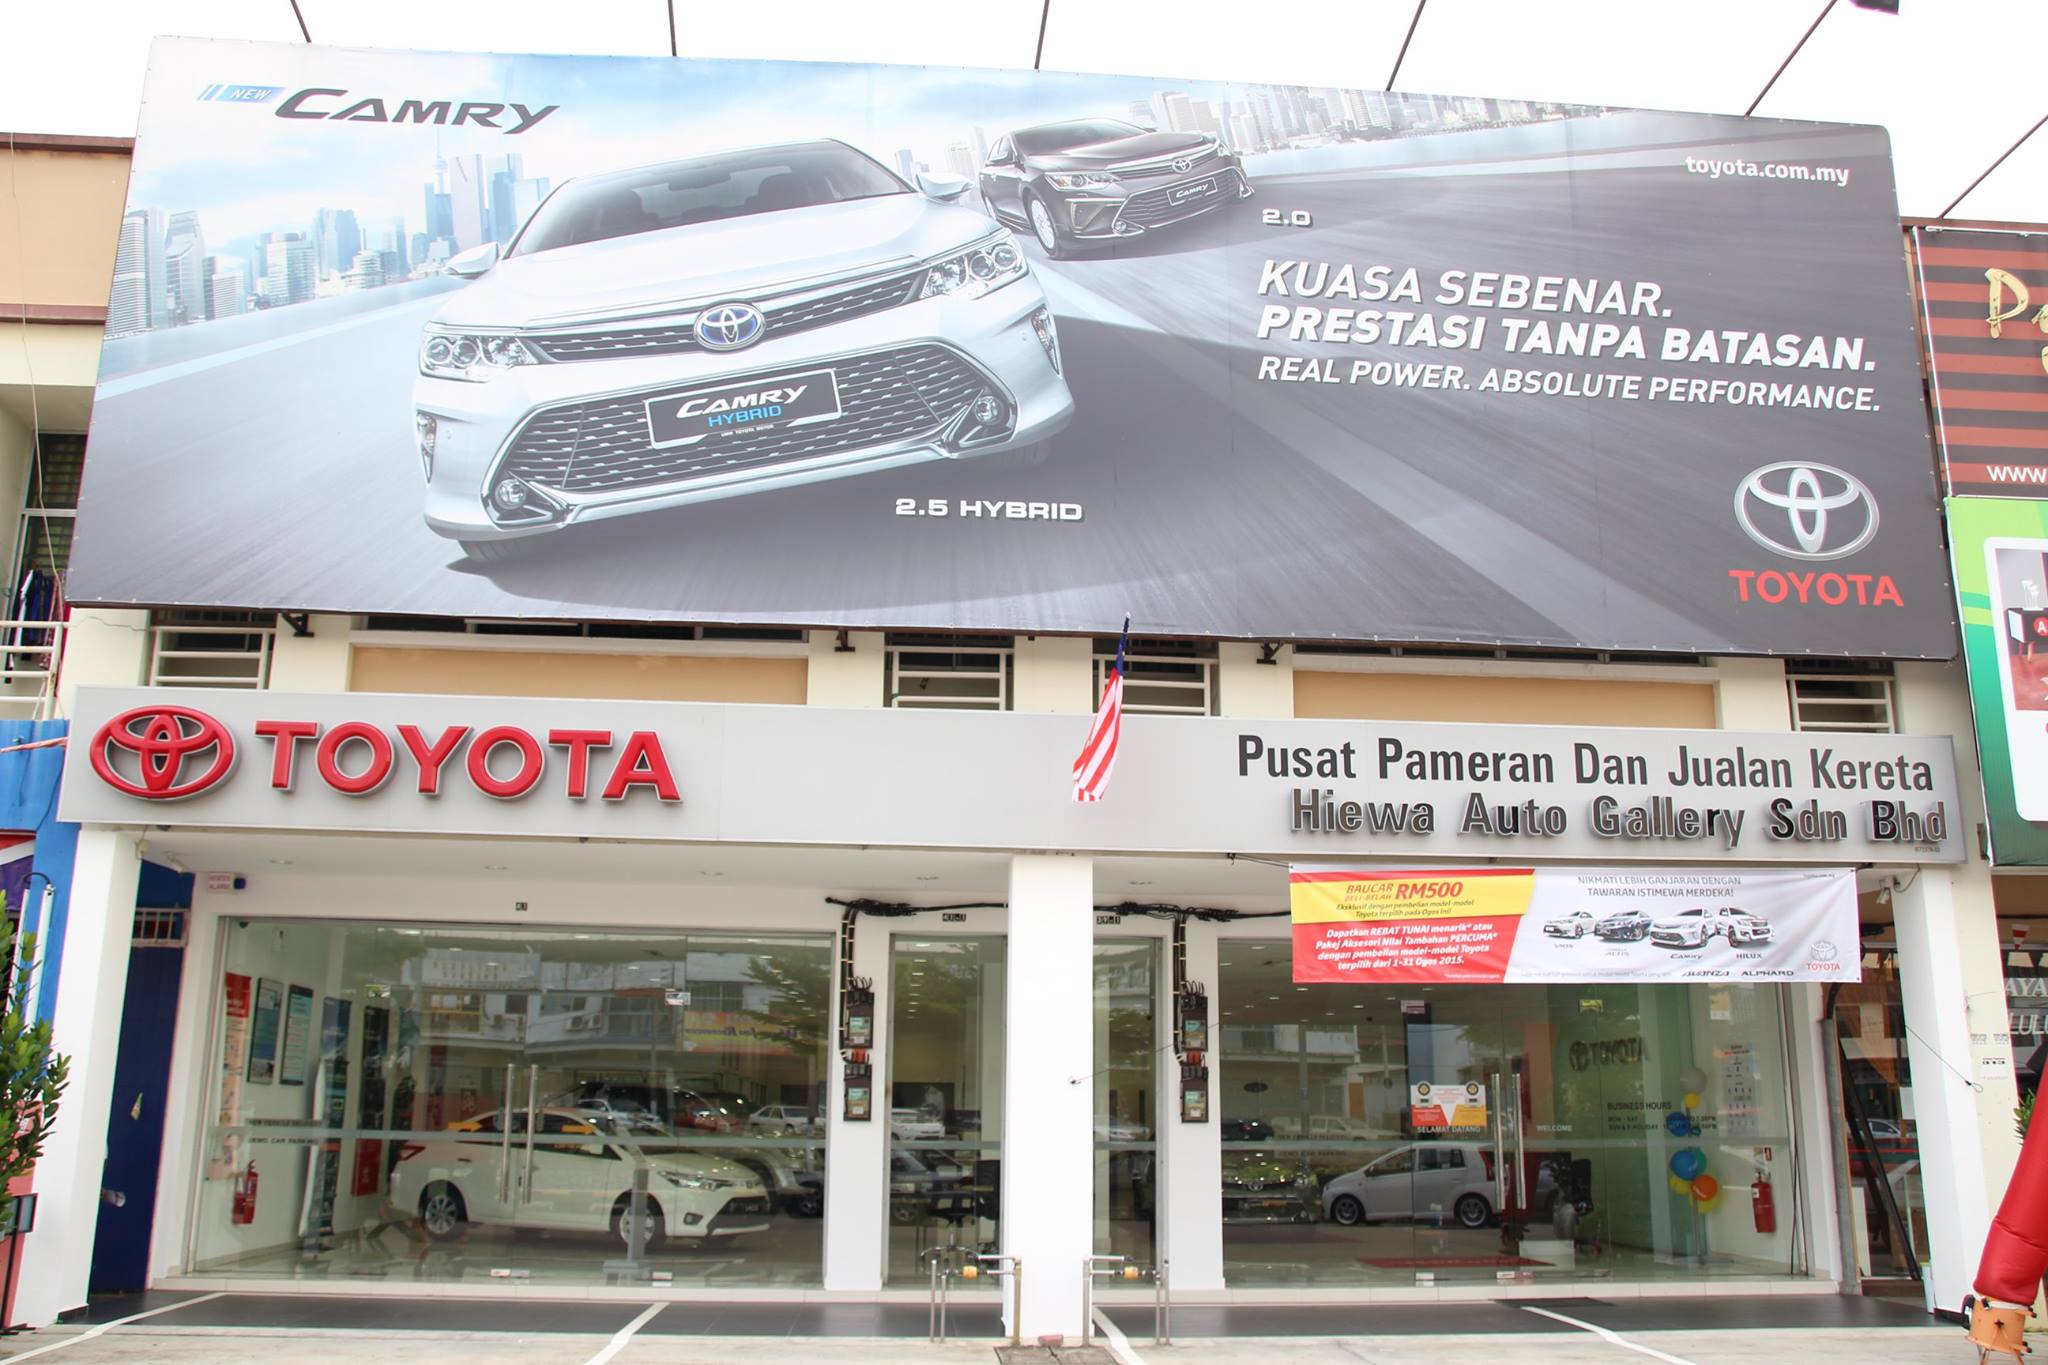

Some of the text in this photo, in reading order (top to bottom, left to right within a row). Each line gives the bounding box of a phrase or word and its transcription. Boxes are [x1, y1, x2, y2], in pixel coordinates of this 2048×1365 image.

[230, 88, 562, 135] NEW CAMRY
[1685, 156, 1849, 187] toyota.com.my
[1176, 183, 1208, 198] CAMRY
[1261, 208, 1312, 226] 2.0
[1257, 259, 1672, 317] KUASA SEBENAR.
[1257, 304, 1876, 371] PRESTASI TANPA BATASAN.
[1257, 356, 1881, 412] REAL POWER. ABSOLUTE PERFORMANCE.
[676, 385, 808, 418] CAMRY
[708, 405, 782, 428] HYBRID
[896, 498, 1084, 521] 2.5 HYBRID
[1728, 569, 1905, 607] TOYOTA
[255, 720, 683, 803] TOYOTA
[1238, 734, 1935, 791] Pusat Pameran Dan Jualan Kereta
[1291, 788, 1950, 849] Hiewa Auto Gallery Sdn Bhd
[1346, 881, 1464, 900] BAUCAR RM500
[1577, 876, 1742, 886] NIKMATI LEBIH GANJARAN DENGAN
[1588, 887, 1734, 898] TAWARAN ISTIMEWA MERDEKA!
[1355, 911, 1379, 919] Toyota
[1404, 909, 1421, 917] pada
[1422, 908, 1440, 916] Ogos
[1393, 901, 1429, 910] pembelian
[1326, 927, 1369, 939] Dapatkan
[1370, 926, 1401, 937] REBAT
[1402, 924, 1430, 934] TUNAI
[1472, 923, 1494, 931] atau
[1315, 940, 1341, 951] Pakej
[1341, 938, 1381, 949] Aksesori
[1381, 936, 1402, 946] Nilai
[1404, 936, 1449, 945] Tambahan
[1317, 944, 1490, 961] dengan pembelian model-model Toyota
[1337, 955, 1465, 971] terpilih dari 1-31 Ogos 2015.
[1807, 963, 1841, 971] TOYOTA
[1607, 1101, 1673, 1110] BUSINESS HOURS
